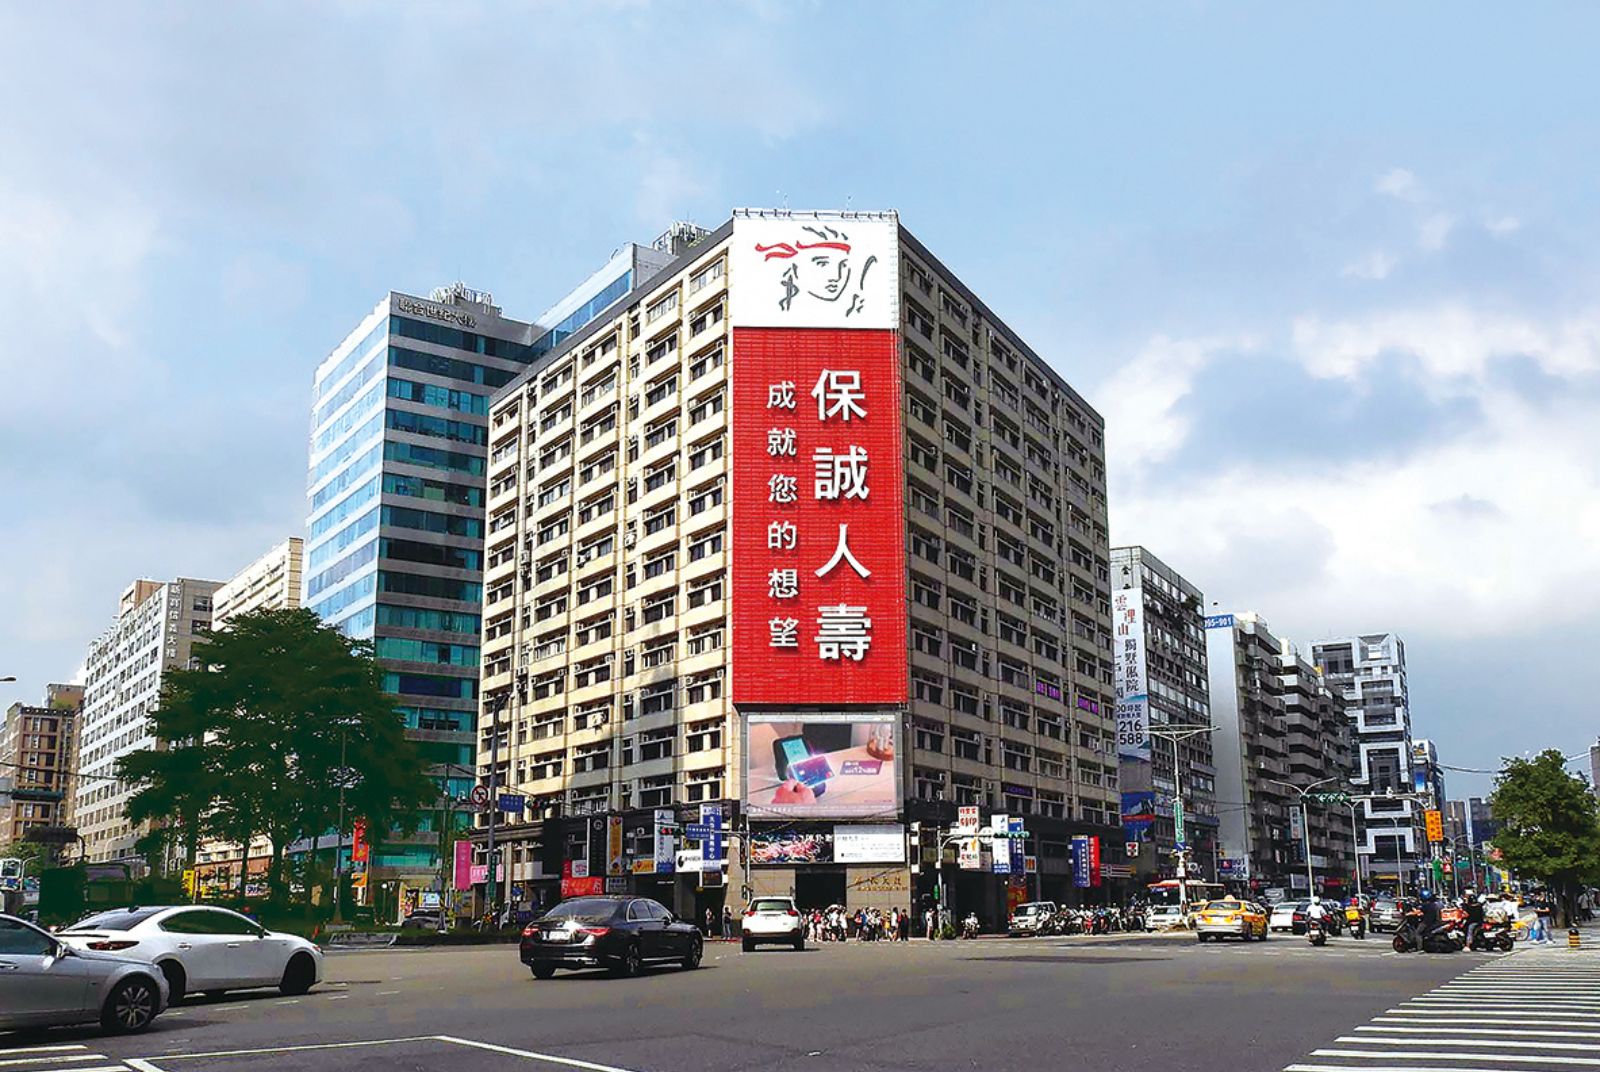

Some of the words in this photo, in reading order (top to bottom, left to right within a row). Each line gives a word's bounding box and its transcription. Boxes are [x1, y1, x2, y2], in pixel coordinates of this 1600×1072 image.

[767, 381, 798, 646] 成就您的想望
[811, 369, 871, 660] 保誠人壽
[1119, 720, 1142, 732] 216
[1119, 732, 1144, 745] 588
